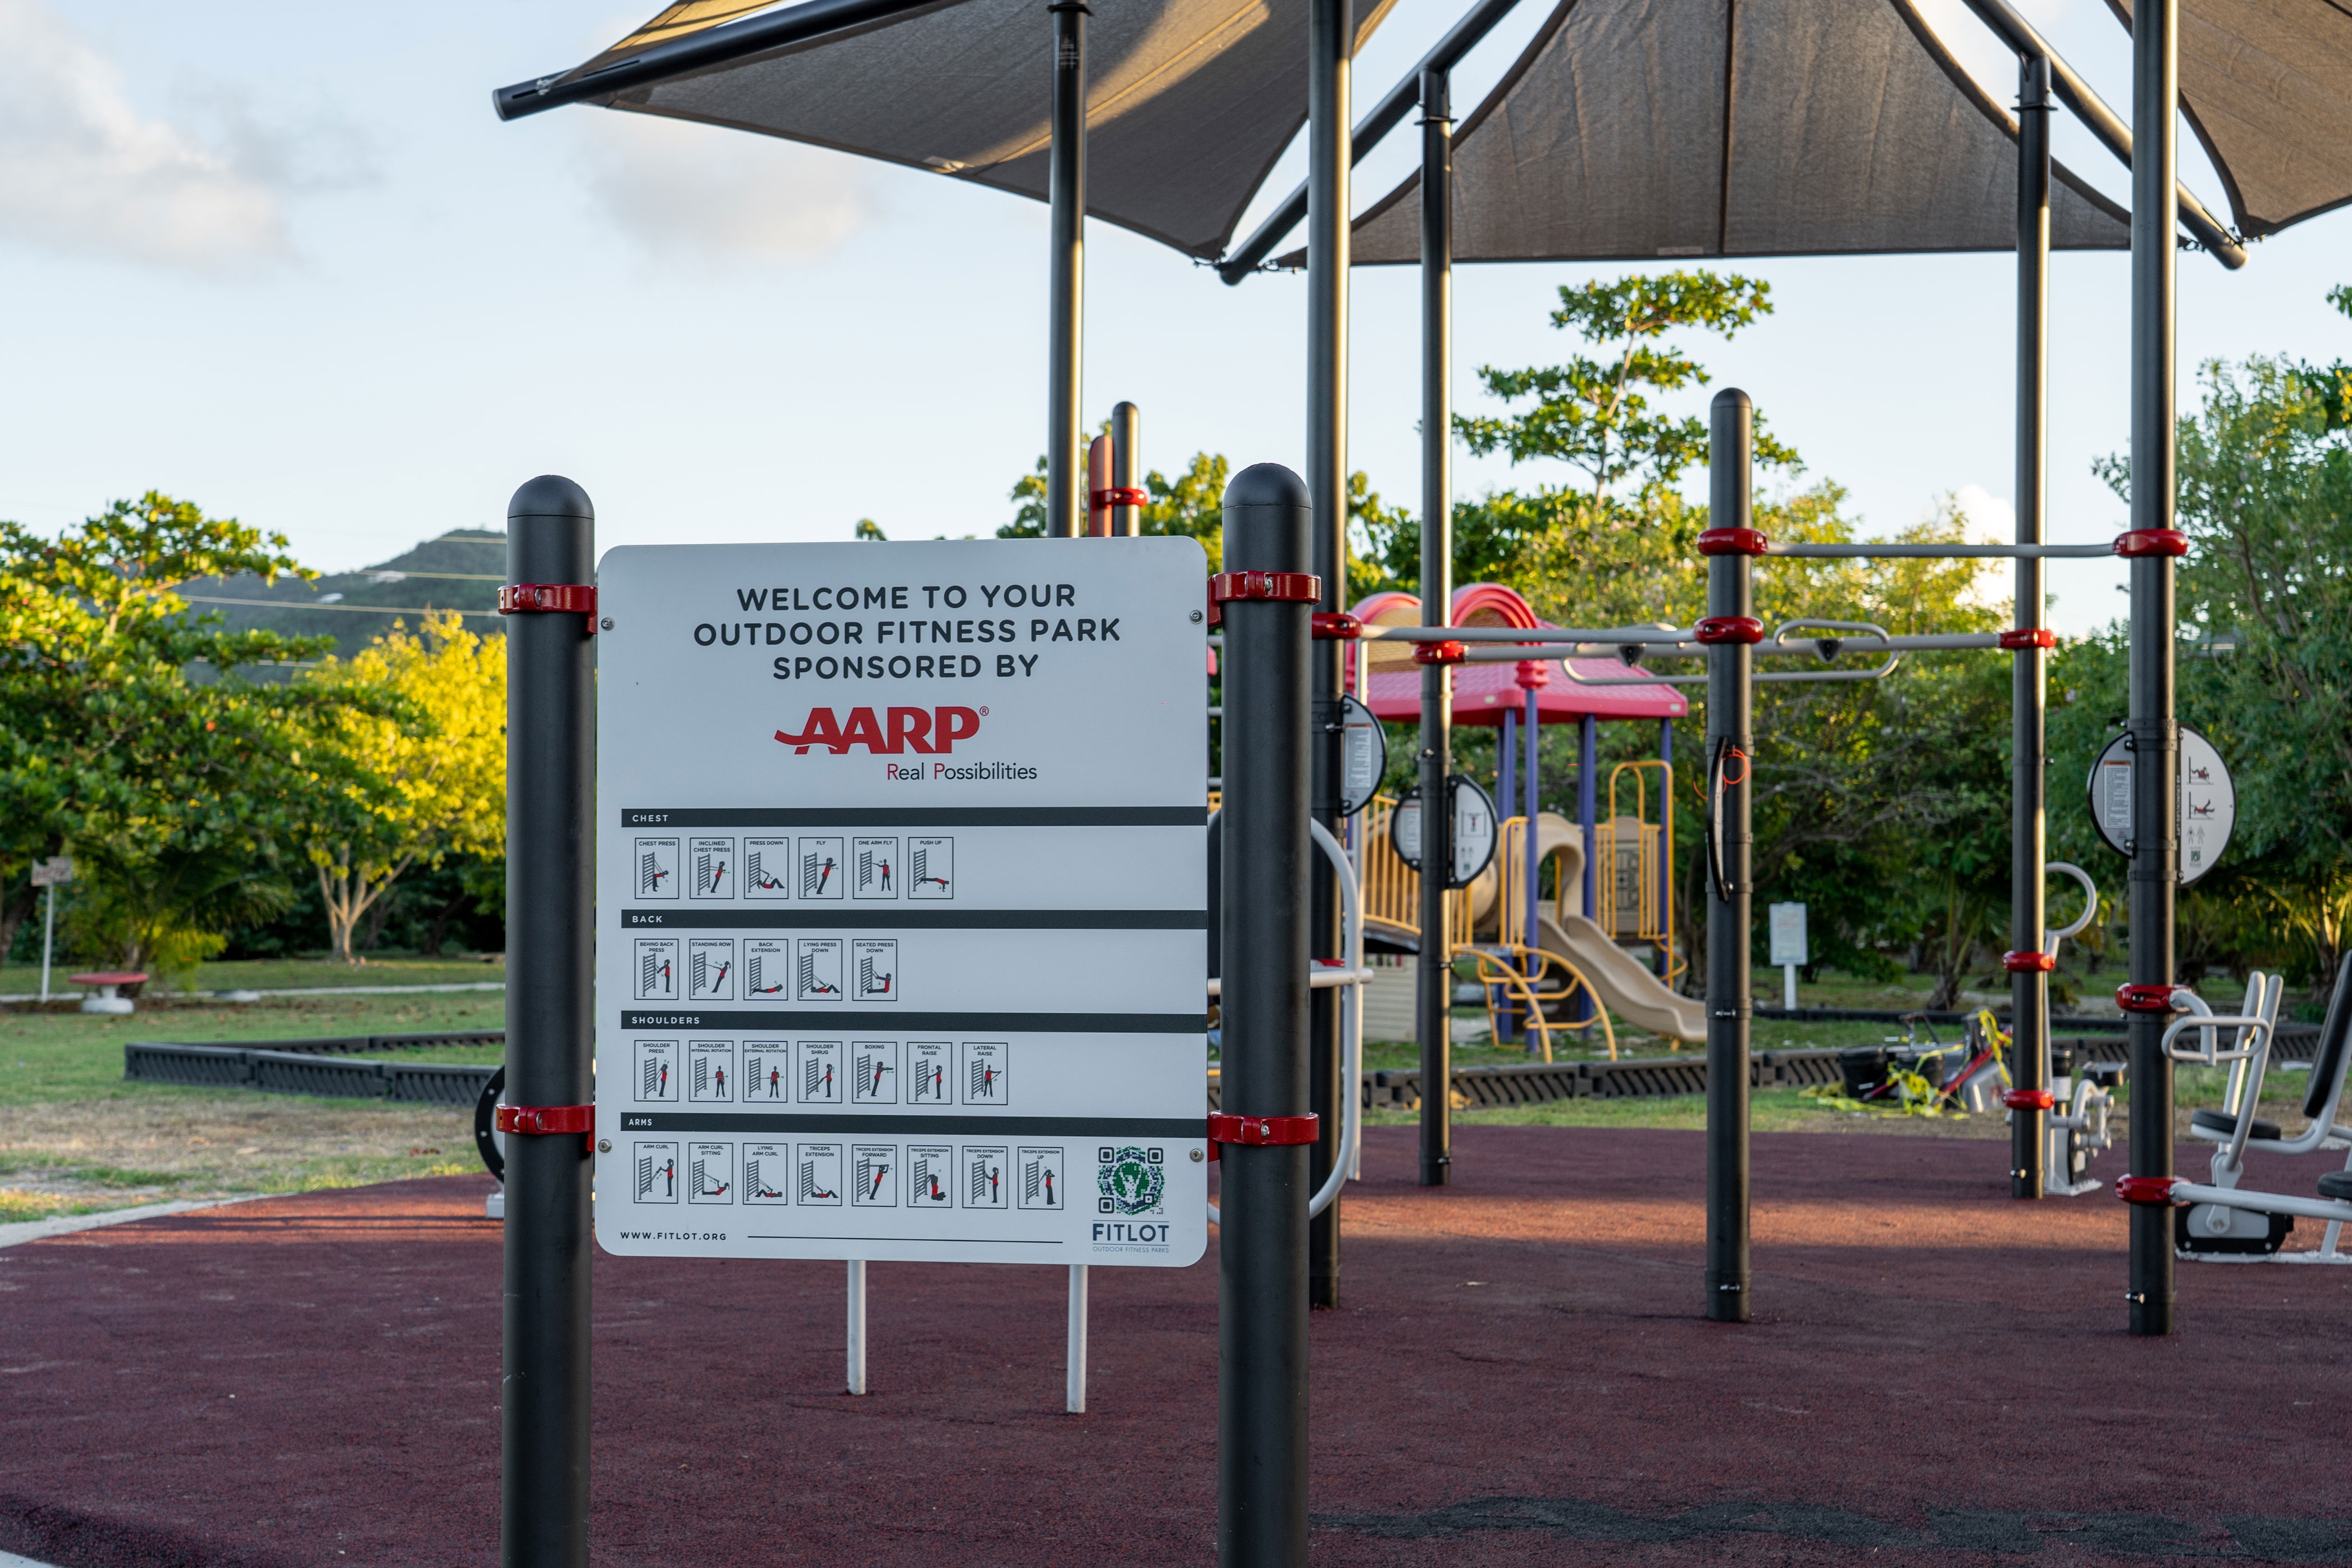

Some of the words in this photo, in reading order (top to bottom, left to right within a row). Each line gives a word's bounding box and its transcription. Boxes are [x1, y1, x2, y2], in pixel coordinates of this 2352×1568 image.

[737, 587, 908, 611] WELCOME
[922, 586, 967, 608] TO
[981, 584, 1074, 608] YOUR
[694, 622, 862, 646] OUTDOOR
[878, 619, 1015, 644] FITNESS
[1031, 618, 1120, 642] PARK
[773, 655, 981, 680] SPONSORED
[997, 654, 1038, 677] BY
[888, 762, 924, 780] Real
[935, 762, 1037, 780] Possibilities
[620, 1232, 726, 1241] WWW.FITLOT.ORG
[1093, 1224, 1169, 1242] FITLOT
